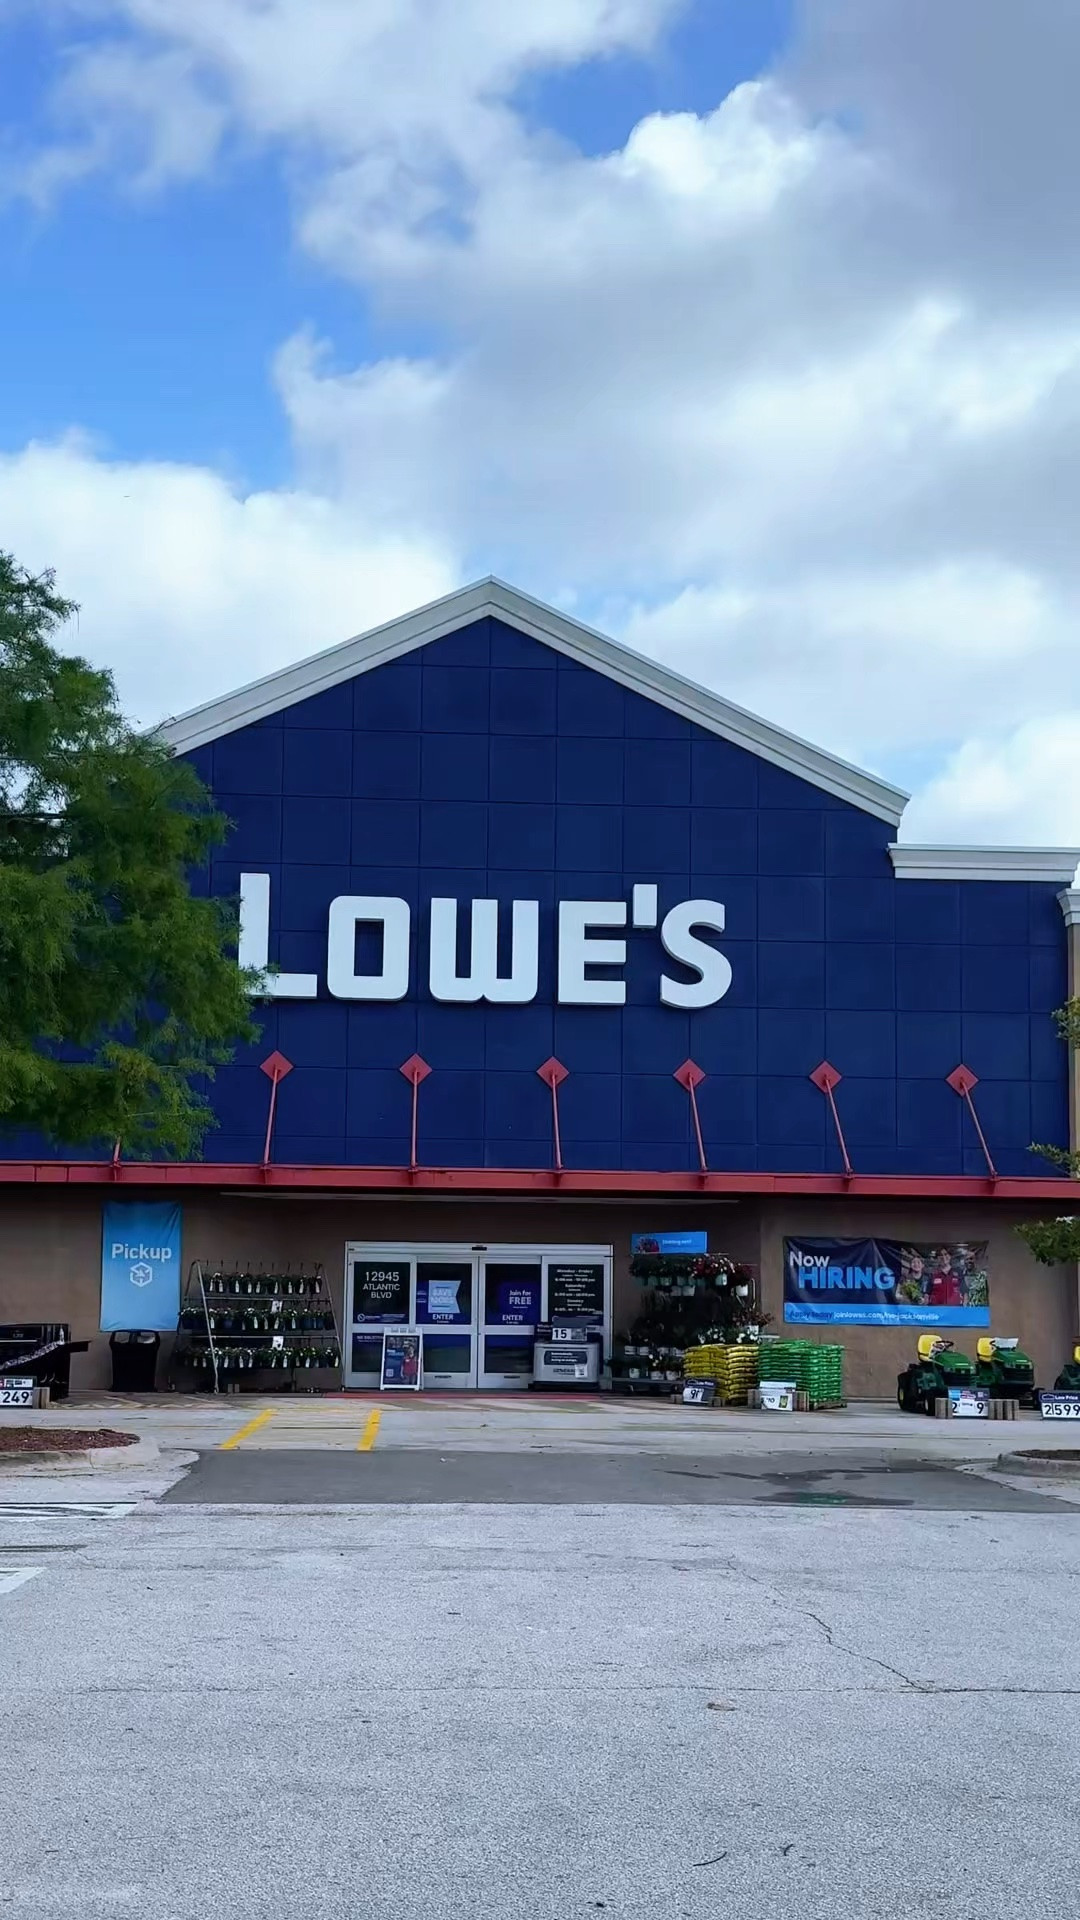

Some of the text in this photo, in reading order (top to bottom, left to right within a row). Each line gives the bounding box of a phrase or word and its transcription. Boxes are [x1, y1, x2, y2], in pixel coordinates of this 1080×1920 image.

[238, 872, 733, 1009] LOWE'S
[111, 1243, 172, 1263] Pickup
[789, 1250, 830, 1268] Now
[365, 1271, 400, 1281] 12945
[797, 1265, 896, 1290] HIRING
[362, 1283, 401, 1291] ATLANTIC
[509, 1297, 532, 1305] FREE
[554, 1328, 568, 1339] 15
